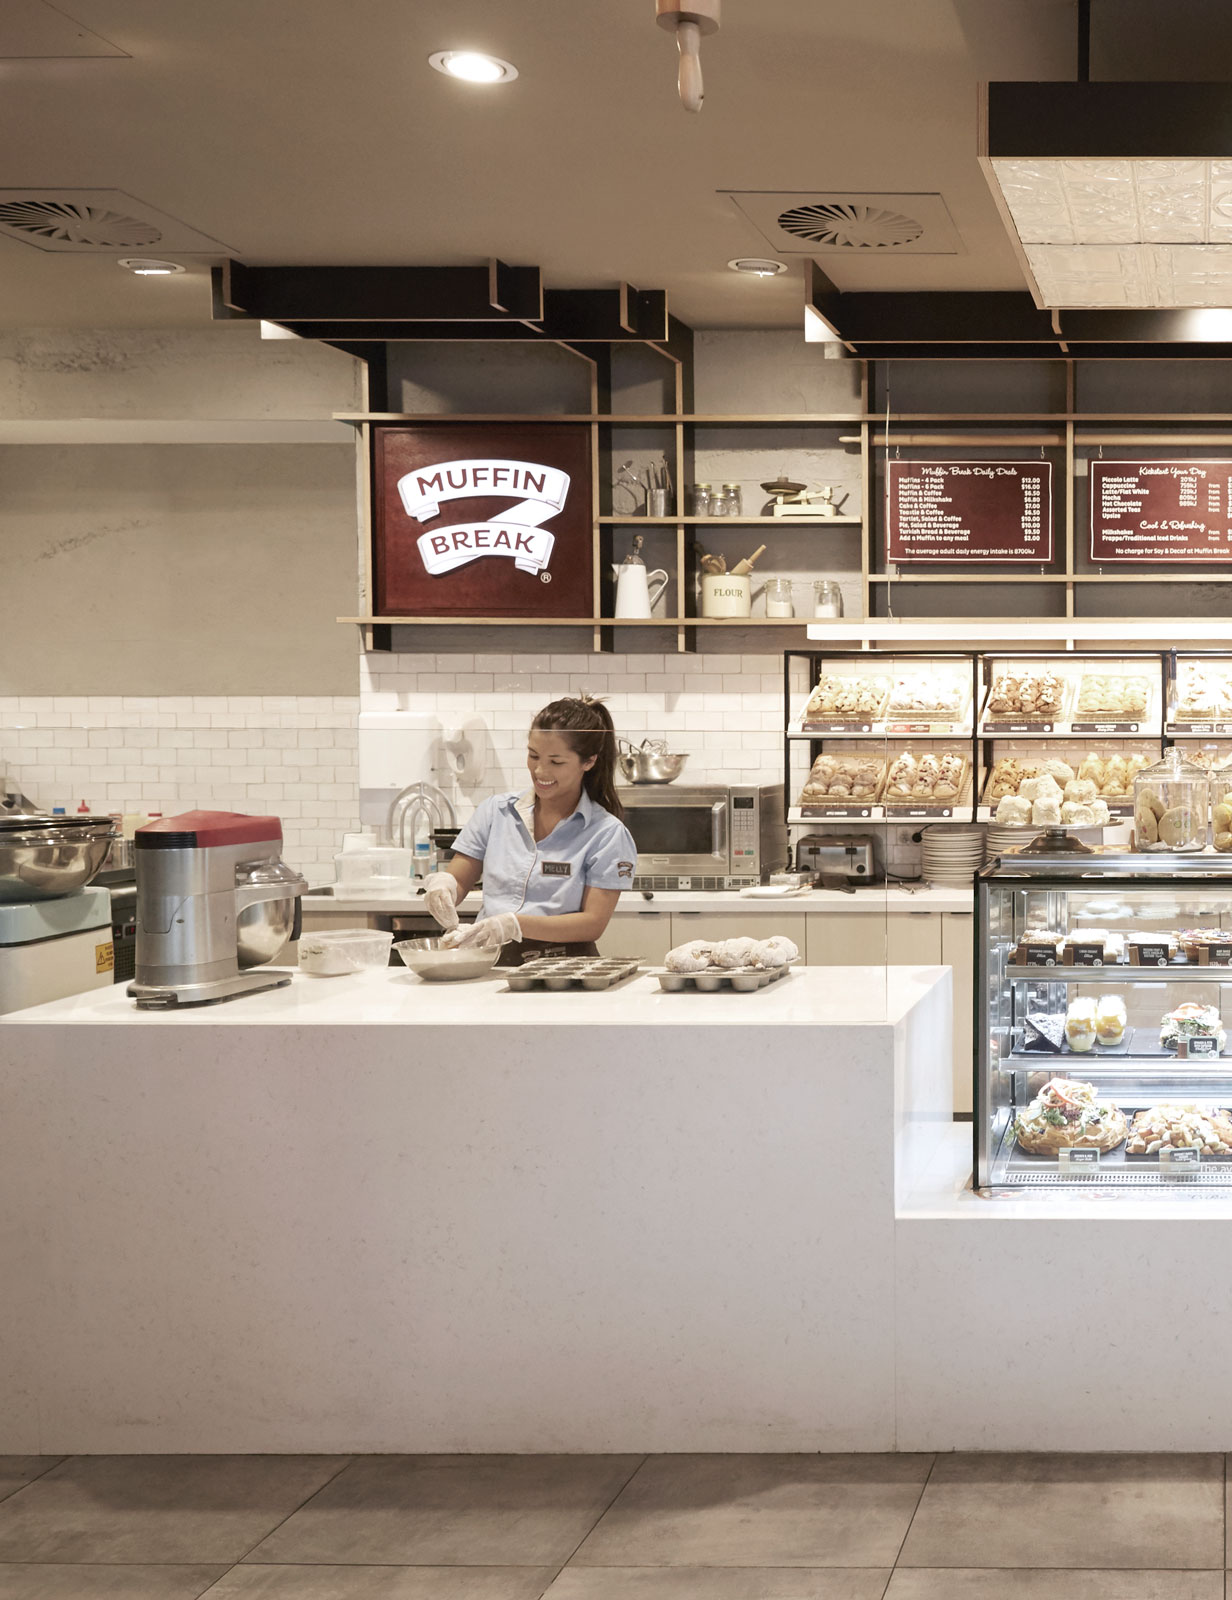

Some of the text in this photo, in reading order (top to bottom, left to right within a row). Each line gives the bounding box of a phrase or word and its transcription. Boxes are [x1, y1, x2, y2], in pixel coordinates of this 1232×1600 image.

[921, 467, 948, 476] Muffin
[973, 468, 995, 479] Daily
[1139, 467, 1207, 478] Kickstart Your Day
[417, 468, 546, 496] MUFFIN
[1140, 520, 1205, 532] Cool Refreshing
[431, 530, 535, 555] BREAK
[714, 588, 743, 598] FLOUR
[544, 864, 568, 873] MELLY
[1200, 1164, 1217, 1173] The
